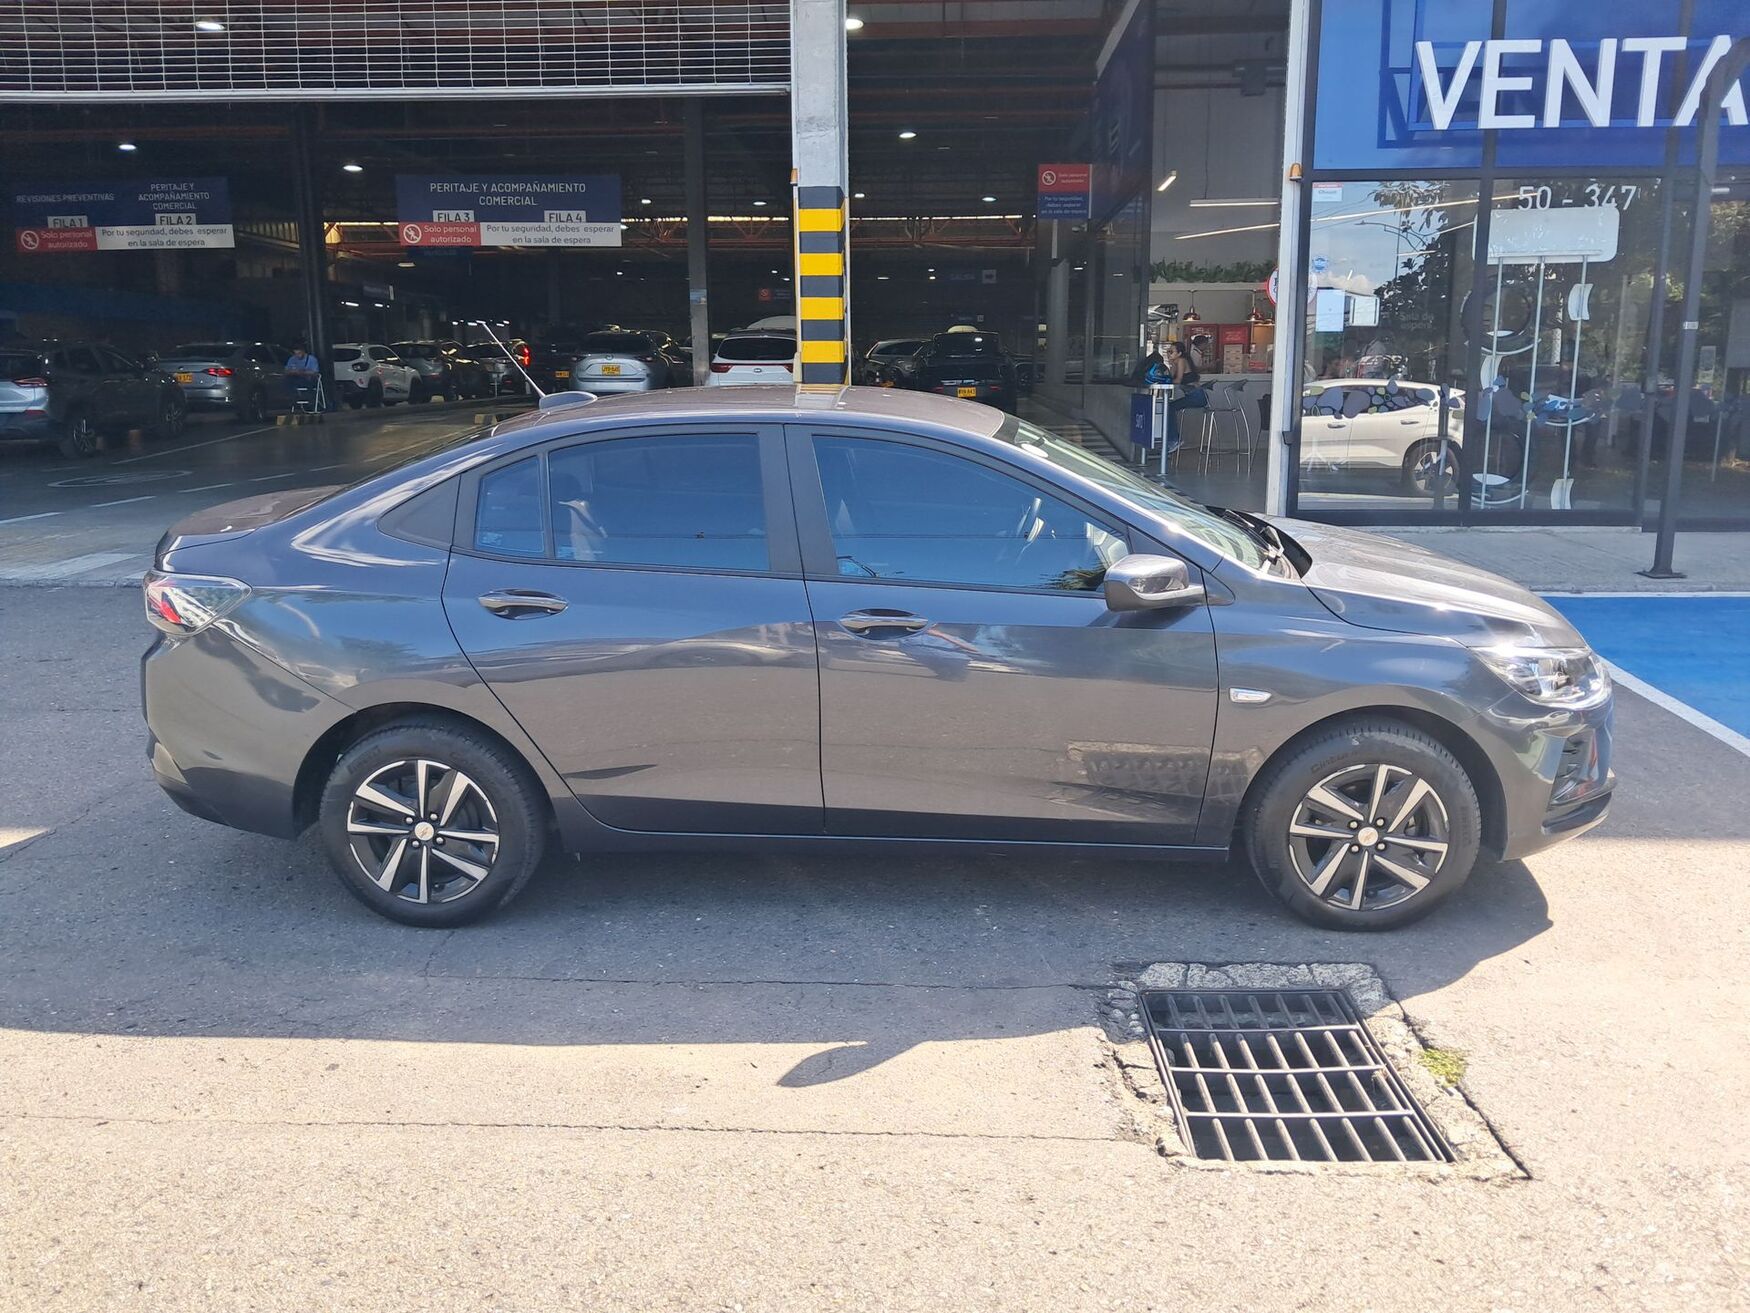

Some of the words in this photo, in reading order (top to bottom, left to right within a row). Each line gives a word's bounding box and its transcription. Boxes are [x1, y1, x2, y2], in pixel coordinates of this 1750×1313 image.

[150, 183, 187, 191] PERITAJE
[188, 182, 195, 191] Y
[430, 183, 479, 192] PERITAJE
[481, 183, 488, 192] Y
[491, 180, 586, 192] ACOMPAÑAMIENTO
[138, 190, 210, 201] ACOMPAÑAMIENTO
[1518, 185, 1552, 210] 50
[1585, 184, 1637, 210] 347
[152, 201, 197, 210] COMERCIAL
[479, 196, 537, 206] COMERCIAL
[160, 216, 183, 225] FILA
[184, 215, 192, 225] 2
[438, 212, 461, 222] FILA
[464, 212, 470, 222] 3
[549, 213, 573, 222] FILA
[575, 213, 582, 222] 4
[53, 218, 75, 227] FILA
[443, 225, 477, 234] personal
[486, 224, 500, 232] Por
[555, 224, 580, 232] debes
[177, 239, 205, 247] espera
[430, 235, 472, 243] autorizado
[563, 237, 591, 245] espera
